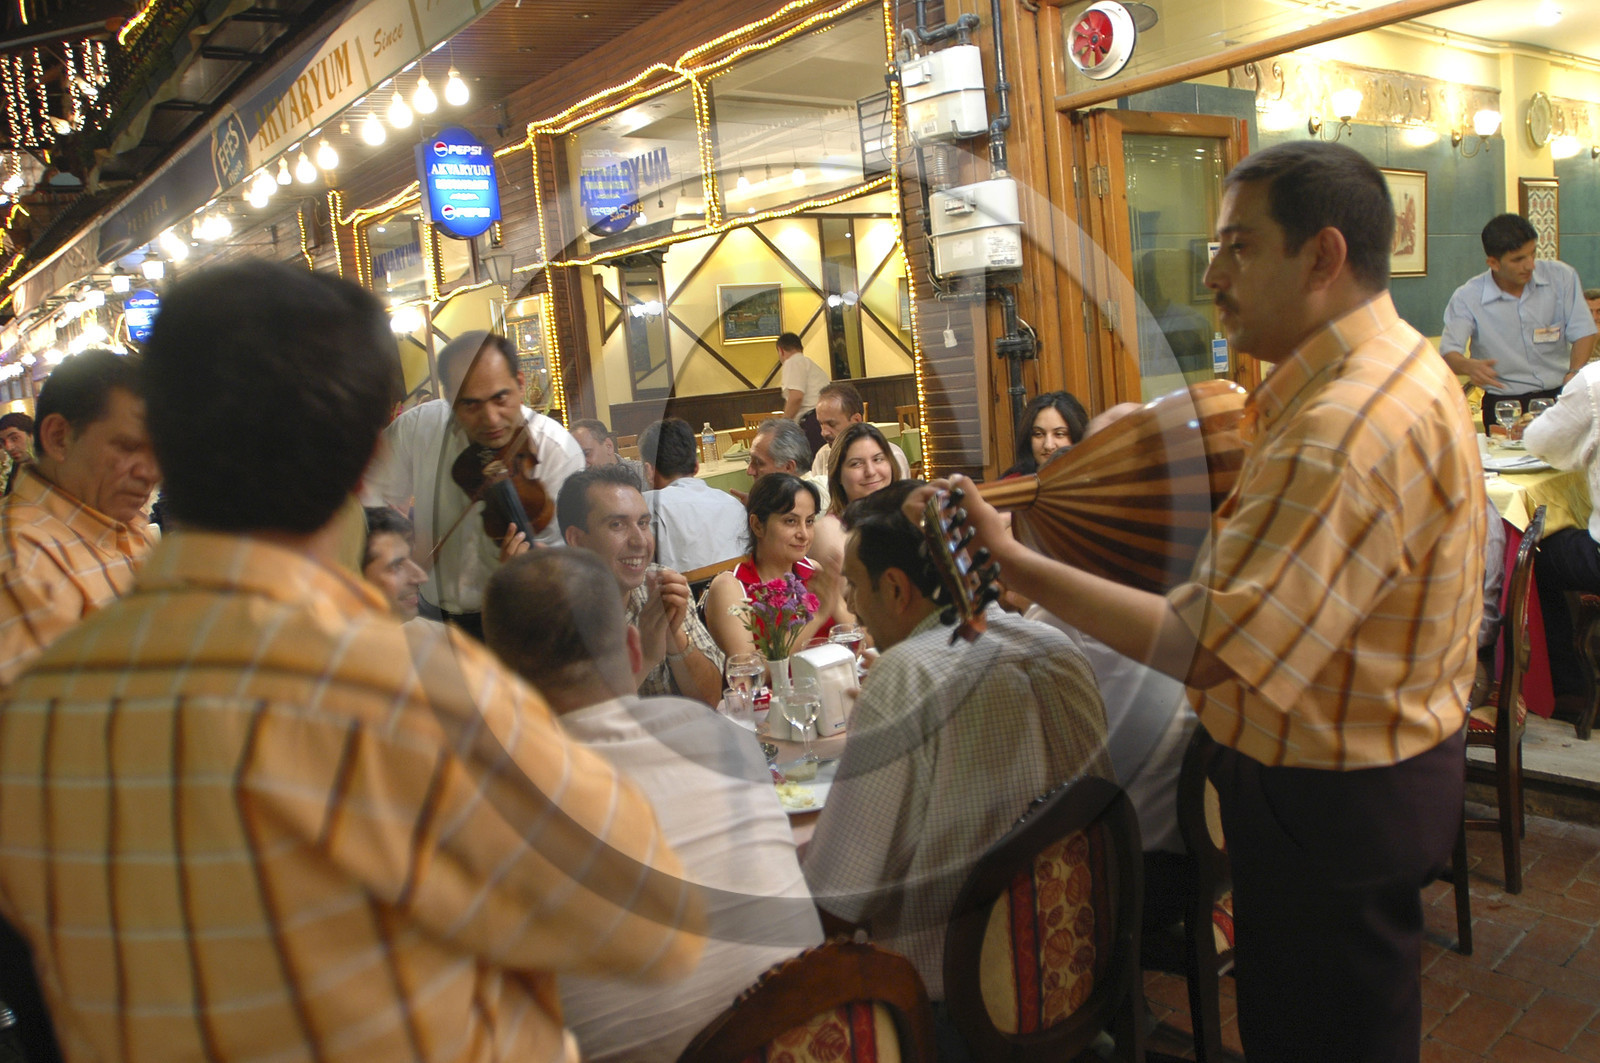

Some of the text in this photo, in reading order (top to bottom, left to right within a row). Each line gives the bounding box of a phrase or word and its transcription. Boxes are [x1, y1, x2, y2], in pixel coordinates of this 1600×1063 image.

[254, 23, 403, 152] AKVARYUM Since
[217, 119, 240, 177] EFES
[448, 144, 482, 156] PEPSI
[431, 163, 491, 176] AKVARYUM
